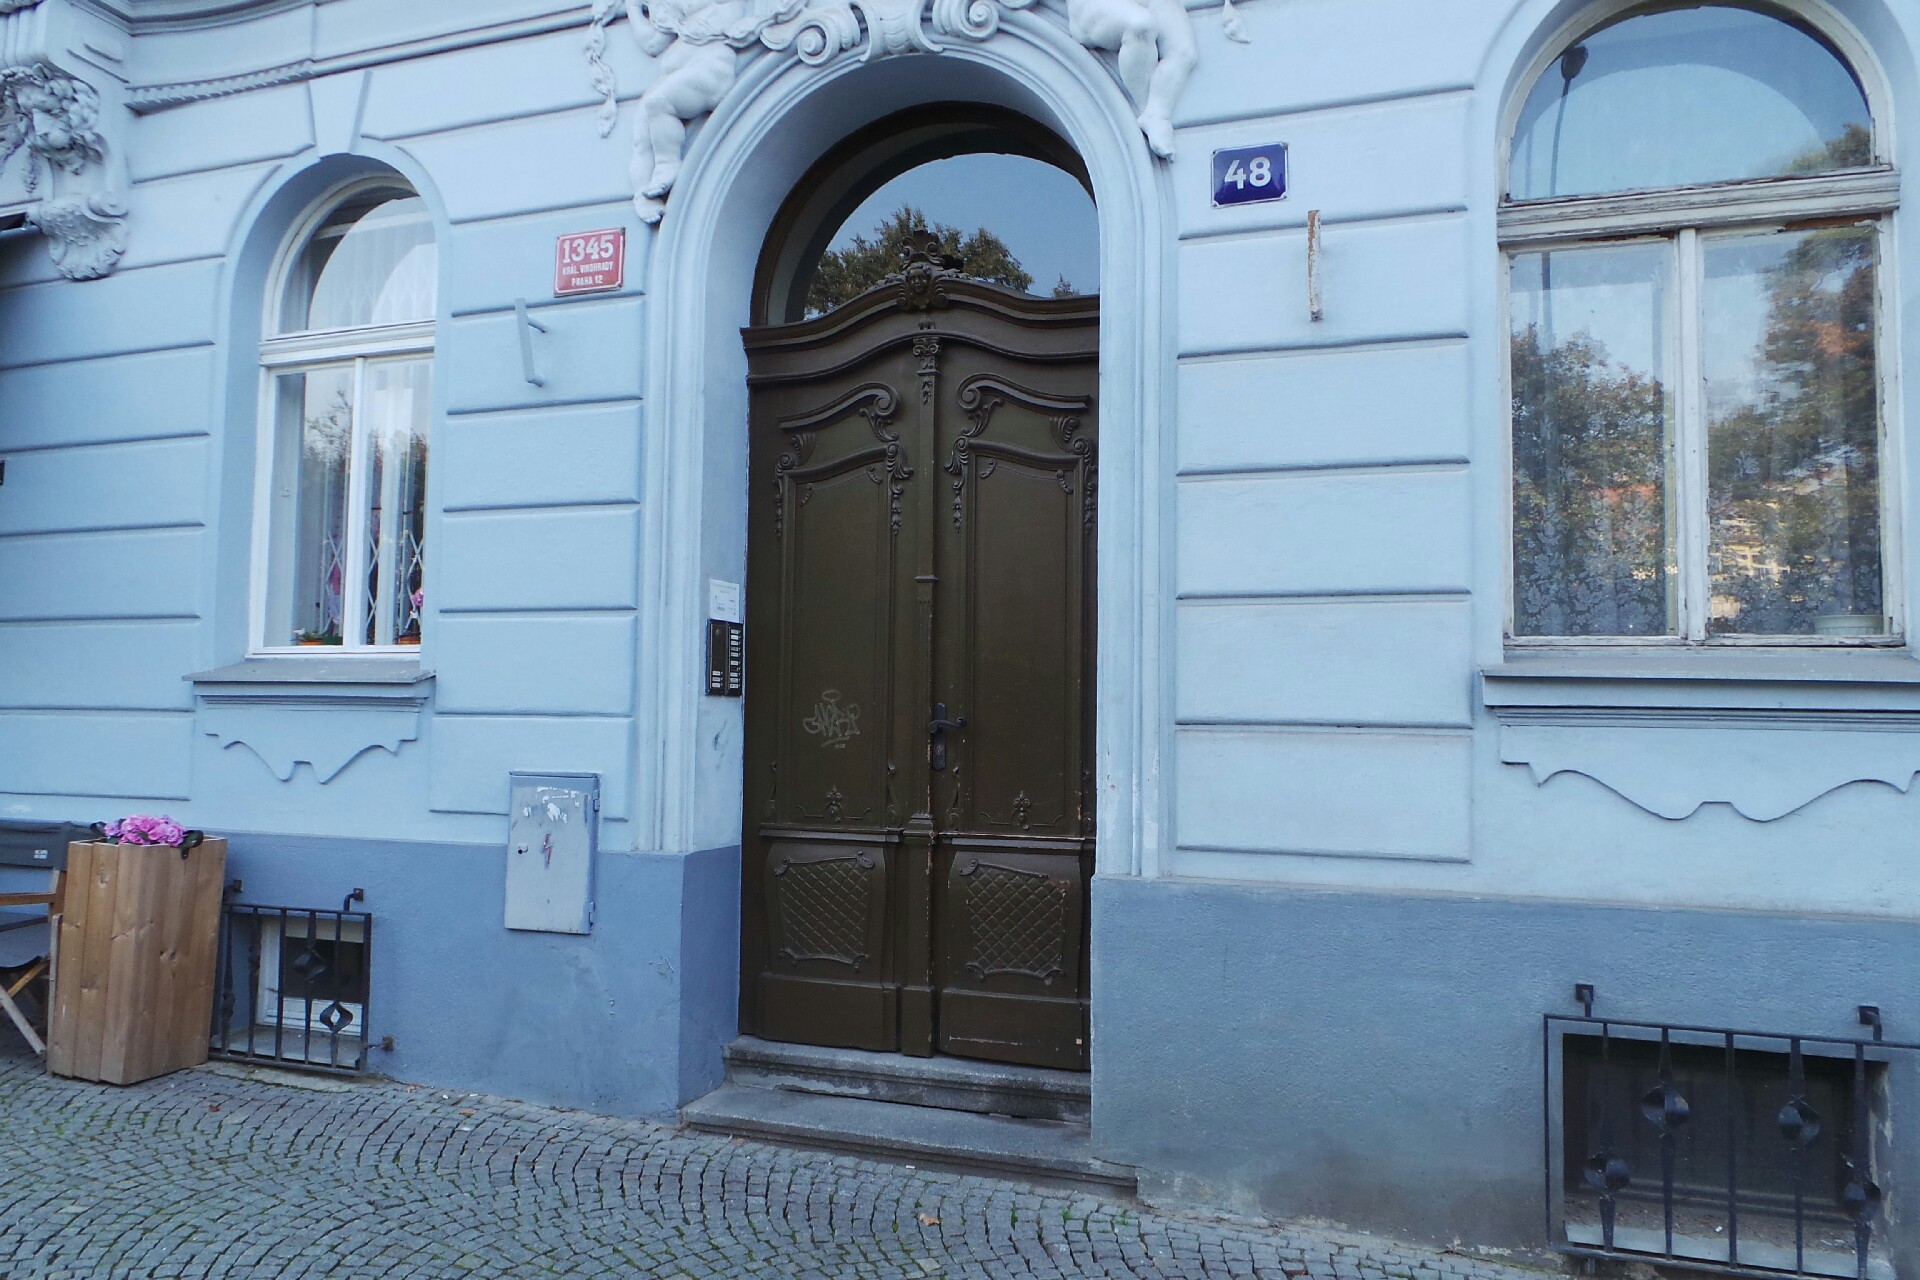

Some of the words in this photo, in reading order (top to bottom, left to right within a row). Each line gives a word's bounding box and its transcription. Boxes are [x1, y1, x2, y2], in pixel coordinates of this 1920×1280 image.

[1224, 156, 1271, 190] 48
[562, 234, 614, 264] 1345
[580, 261, 614, 273] VINOHRADY
[571, 276, 593, 287] PRAHA
